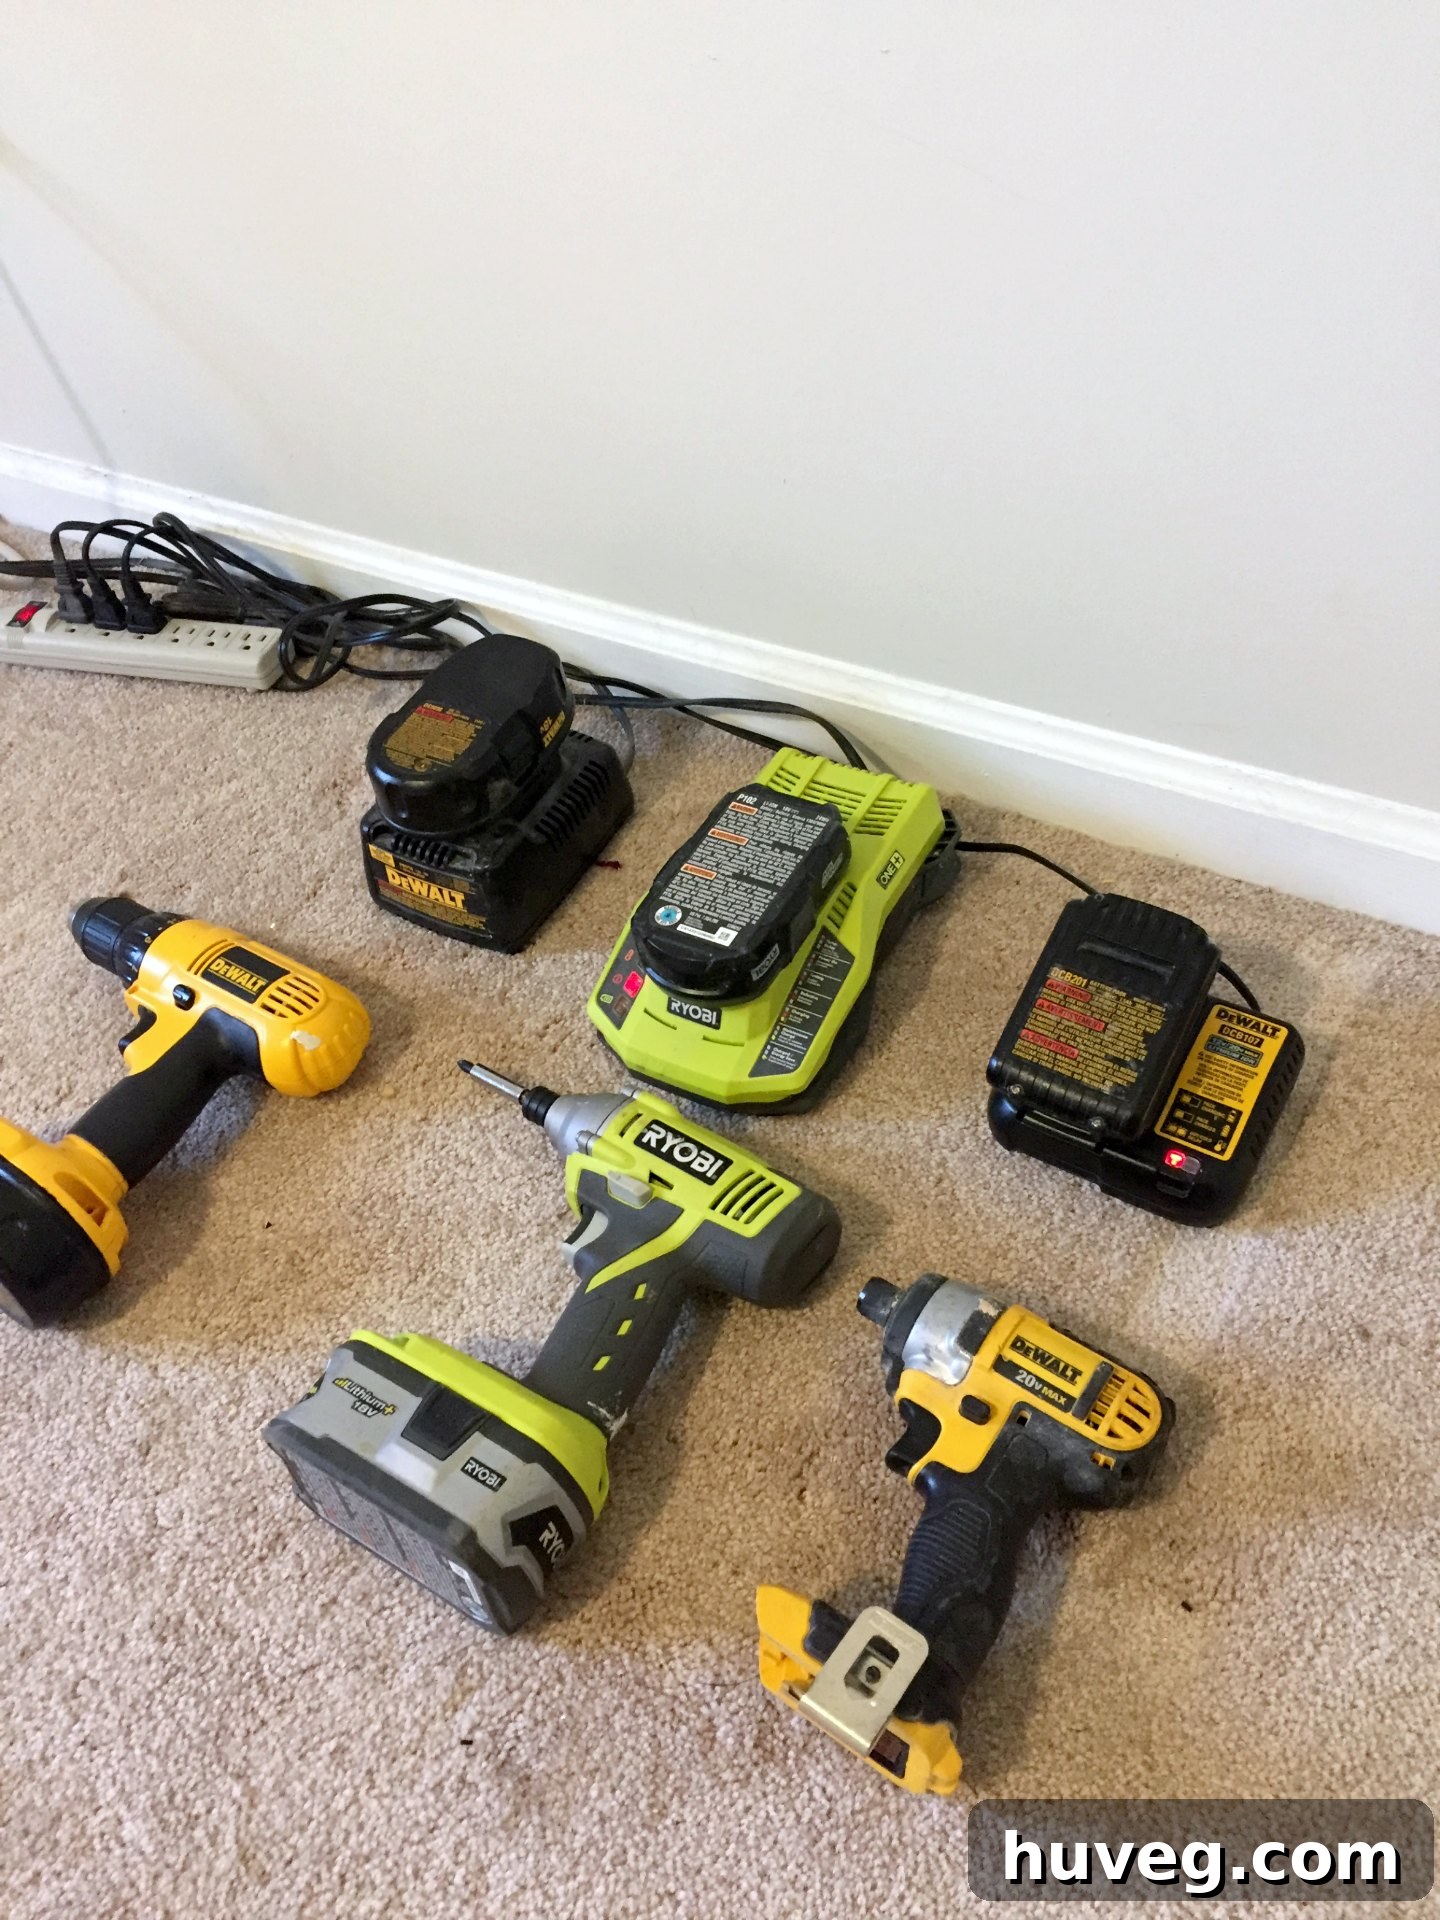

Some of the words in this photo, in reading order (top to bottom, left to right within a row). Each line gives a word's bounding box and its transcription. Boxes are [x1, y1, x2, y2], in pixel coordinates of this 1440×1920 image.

[736, 793, 758, 805] P102
[385, 864, 466, 910] DEWALT
[208, 957, 267, 993] DEWALT
[1050, 966, 1089, 988] DCB201
[670, 999, 717, 1025] RYOBI
[1215, 1007, 1282, 1038] DEWALT
[1221, 1026, 1261, 1046] DCB107
[641, 1123, 725, 1178] RYOBI
[1010, 1337, 1084, 1384] DEWALT
[354, 1401, 378, 1416] 18V
[1042, 1386, 1067, 1405] MAX
[464, 1459, 502, 1488] RYOBI
[539, 1521, 566, 1569] RYO
